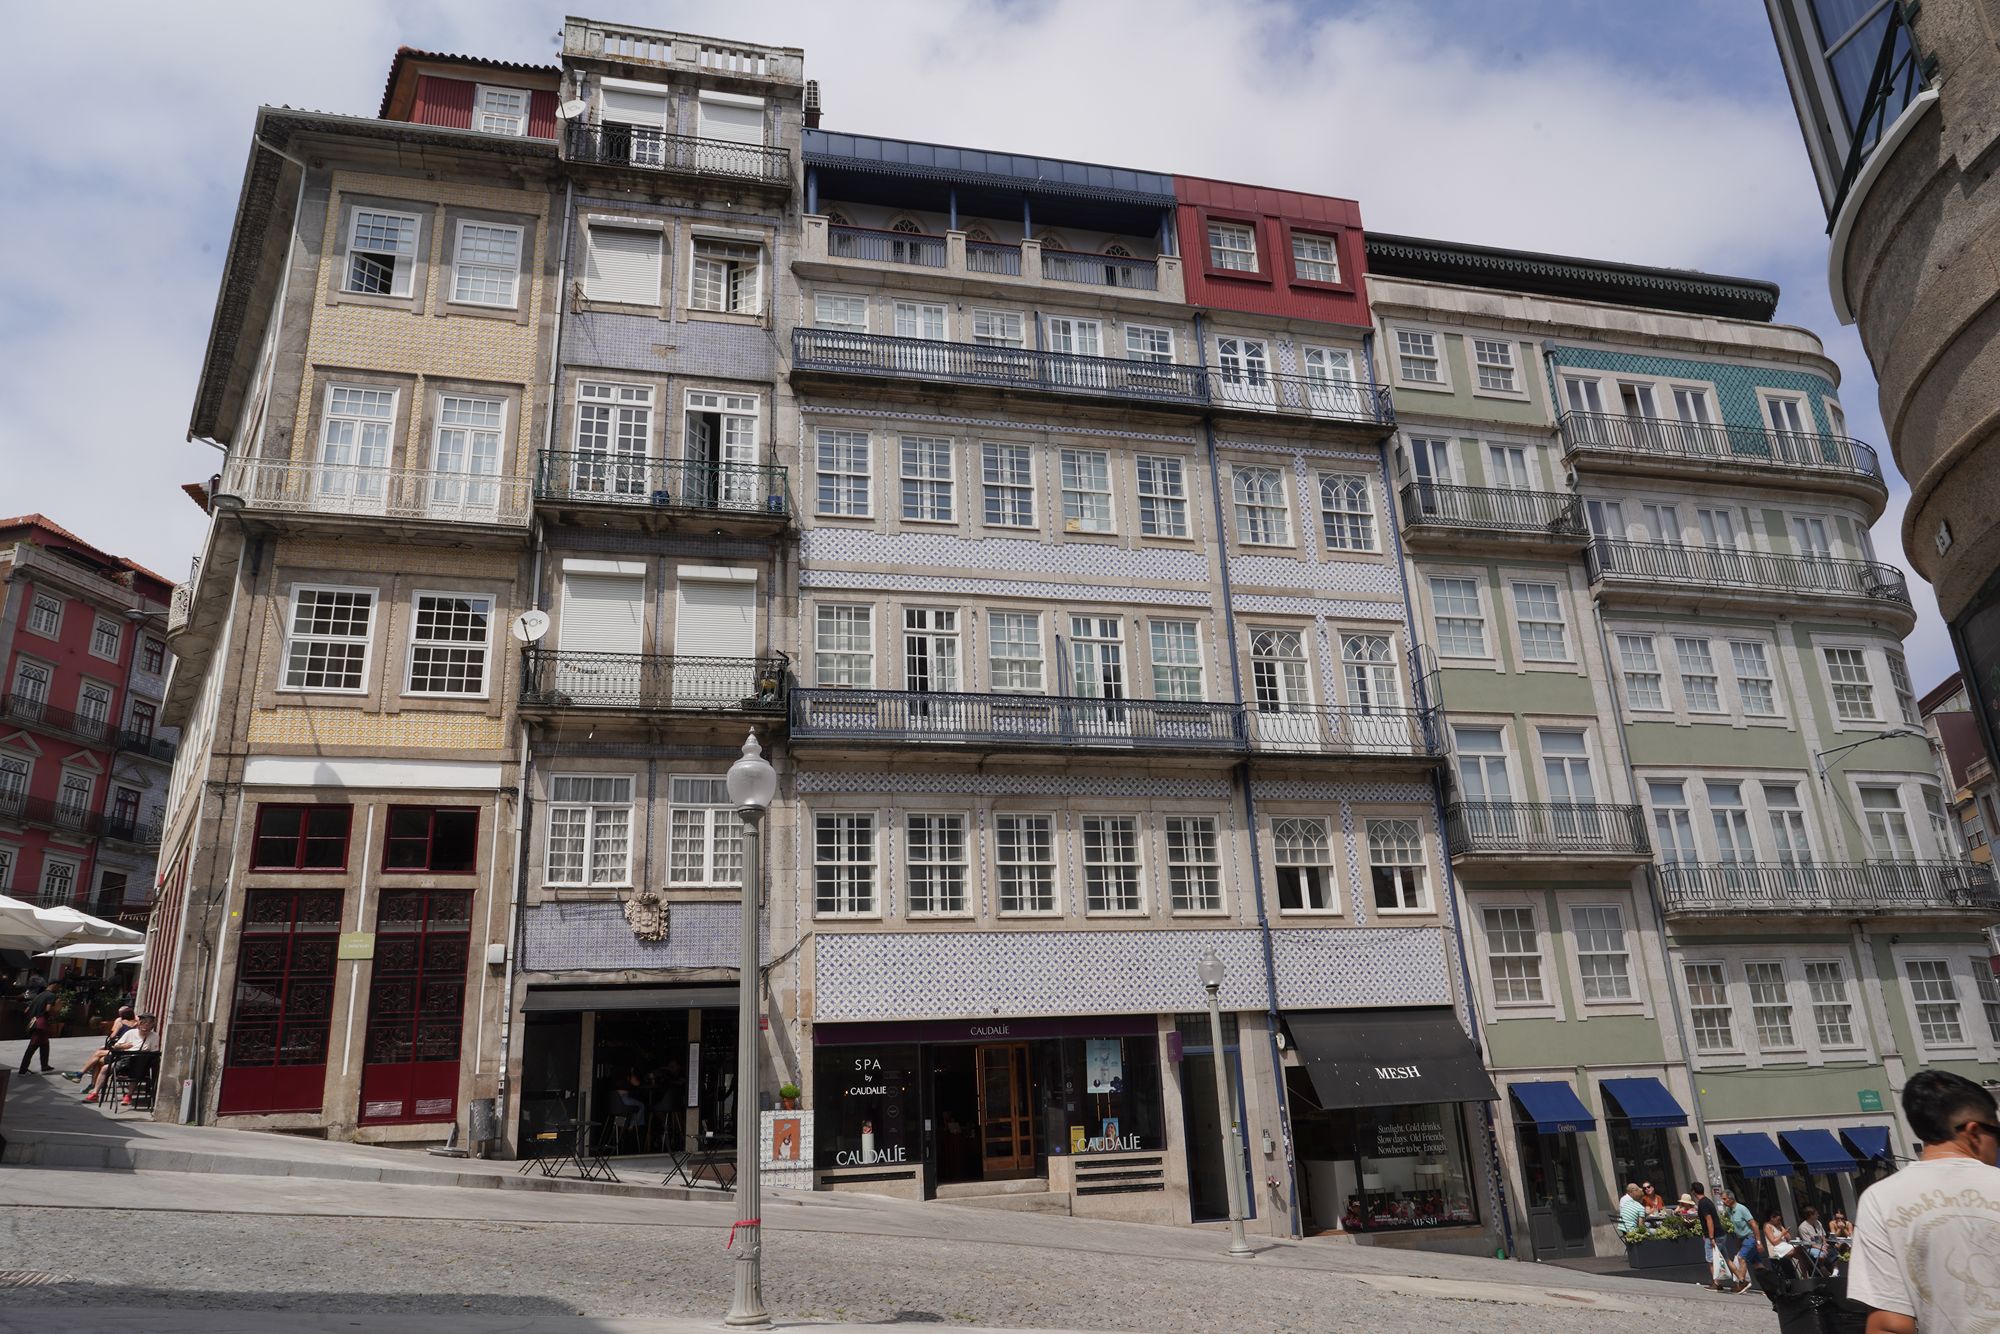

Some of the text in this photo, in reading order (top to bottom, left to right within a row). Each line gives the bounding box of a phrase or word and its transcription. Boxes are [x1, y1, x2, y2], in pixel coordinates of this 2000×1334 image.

[855, 1059, 881, 1071] SPA
[864, 1074, 873, 1082] by
[1374, 1065, 1422, 1080] MESH
[1405, 1122, 1420, 1131] Cold
[1077, 1133, 1142, 1152] CAUDALÍE
[1377, 1135, 1392, 1144] Slow
[1410, 1133, 1421, 1142] Old
[836, 1144, 907, 1166] CAUDALÍE
[1378, 1144, 1405, 1155] Nowhere
[1886, 1192, 1937, 1229] Work
[1933, 1189, 1960, 1208] In
